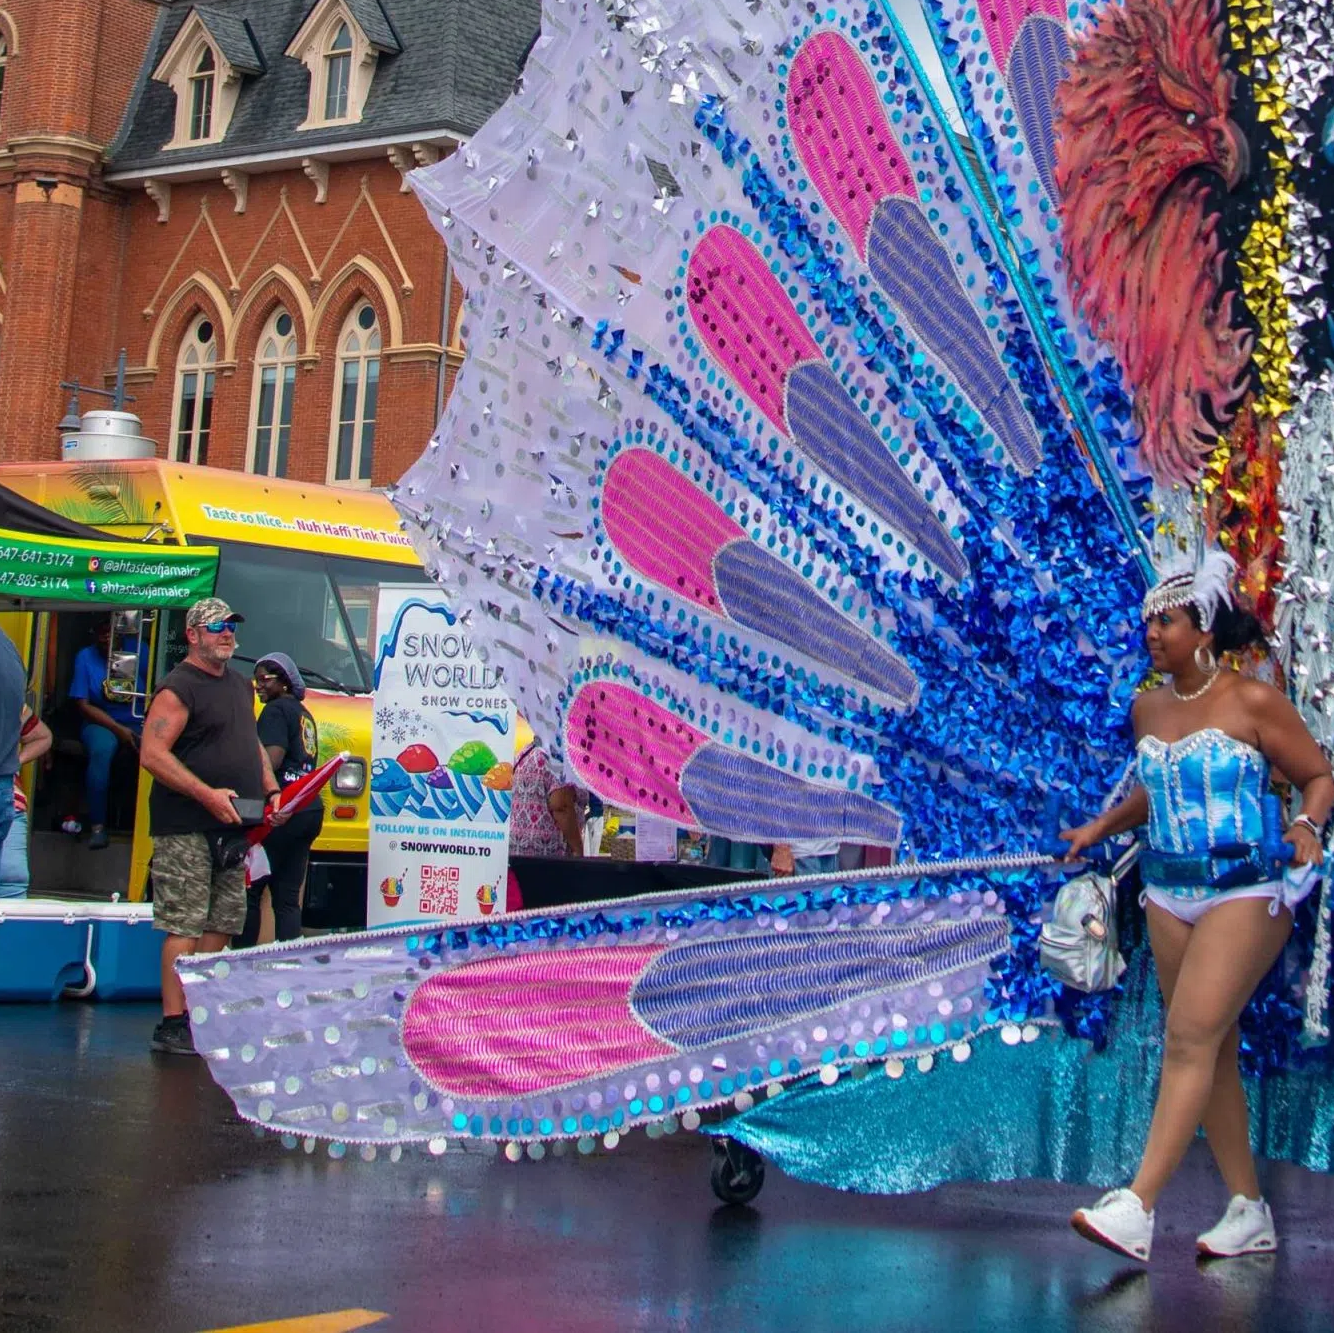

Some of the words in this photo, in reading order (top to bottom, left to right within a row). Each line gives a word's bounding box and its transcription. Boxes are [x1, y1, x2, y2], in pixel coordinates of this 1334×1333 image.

[203, 506, 238, 522] Taste
[240, 513, 254, 524] so
[256, 514, 295, 530] Nice...
[296, 519, 321, 534] Nuh
[324, 524, 352, 539] Haffi
[353, 527, 378, 542] Tink
[103, 559, 201, 578] @ahtasteofjamaica
[101, 580, 191, 598] ahtasteofjamaica
[405, 663, 500, 690] WORLD
[421, 696, 460, 707] SNOW
[466, 697, 508, 709] CONES
[375, 823, 415, 834] FOLLOW
[418, 825, 430, 835] US
[432, 826, 447, 835] ON
[450, 828, 505, 840] INSTAGRAM
[389, 841, 397, 850] @
[400, 841, 491, 857] SNOWYWORLD.TO
